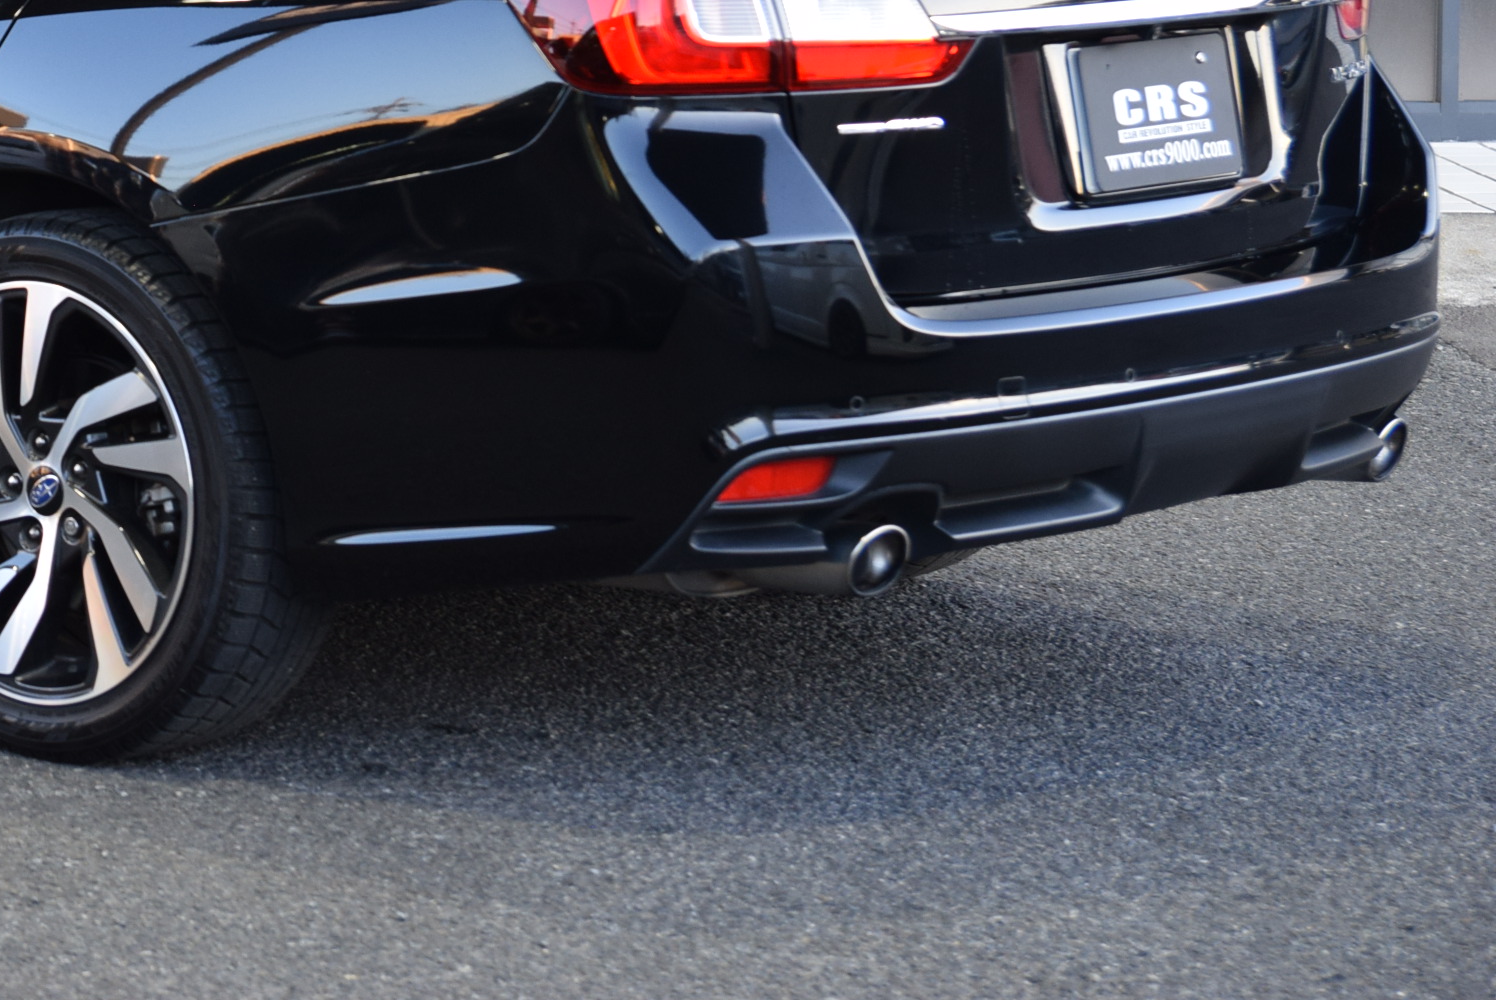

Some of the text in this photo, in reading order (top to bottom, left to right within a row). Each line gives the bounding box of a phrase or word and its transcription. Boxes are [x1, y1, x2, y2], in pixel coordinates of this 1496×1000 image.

[1112, 80, 1210, 126] CRS
[1123, 121, 1207, 139] CAR REVOLUTION STYLE
[1104, 138, 1233, 172] www.crs9000.com
